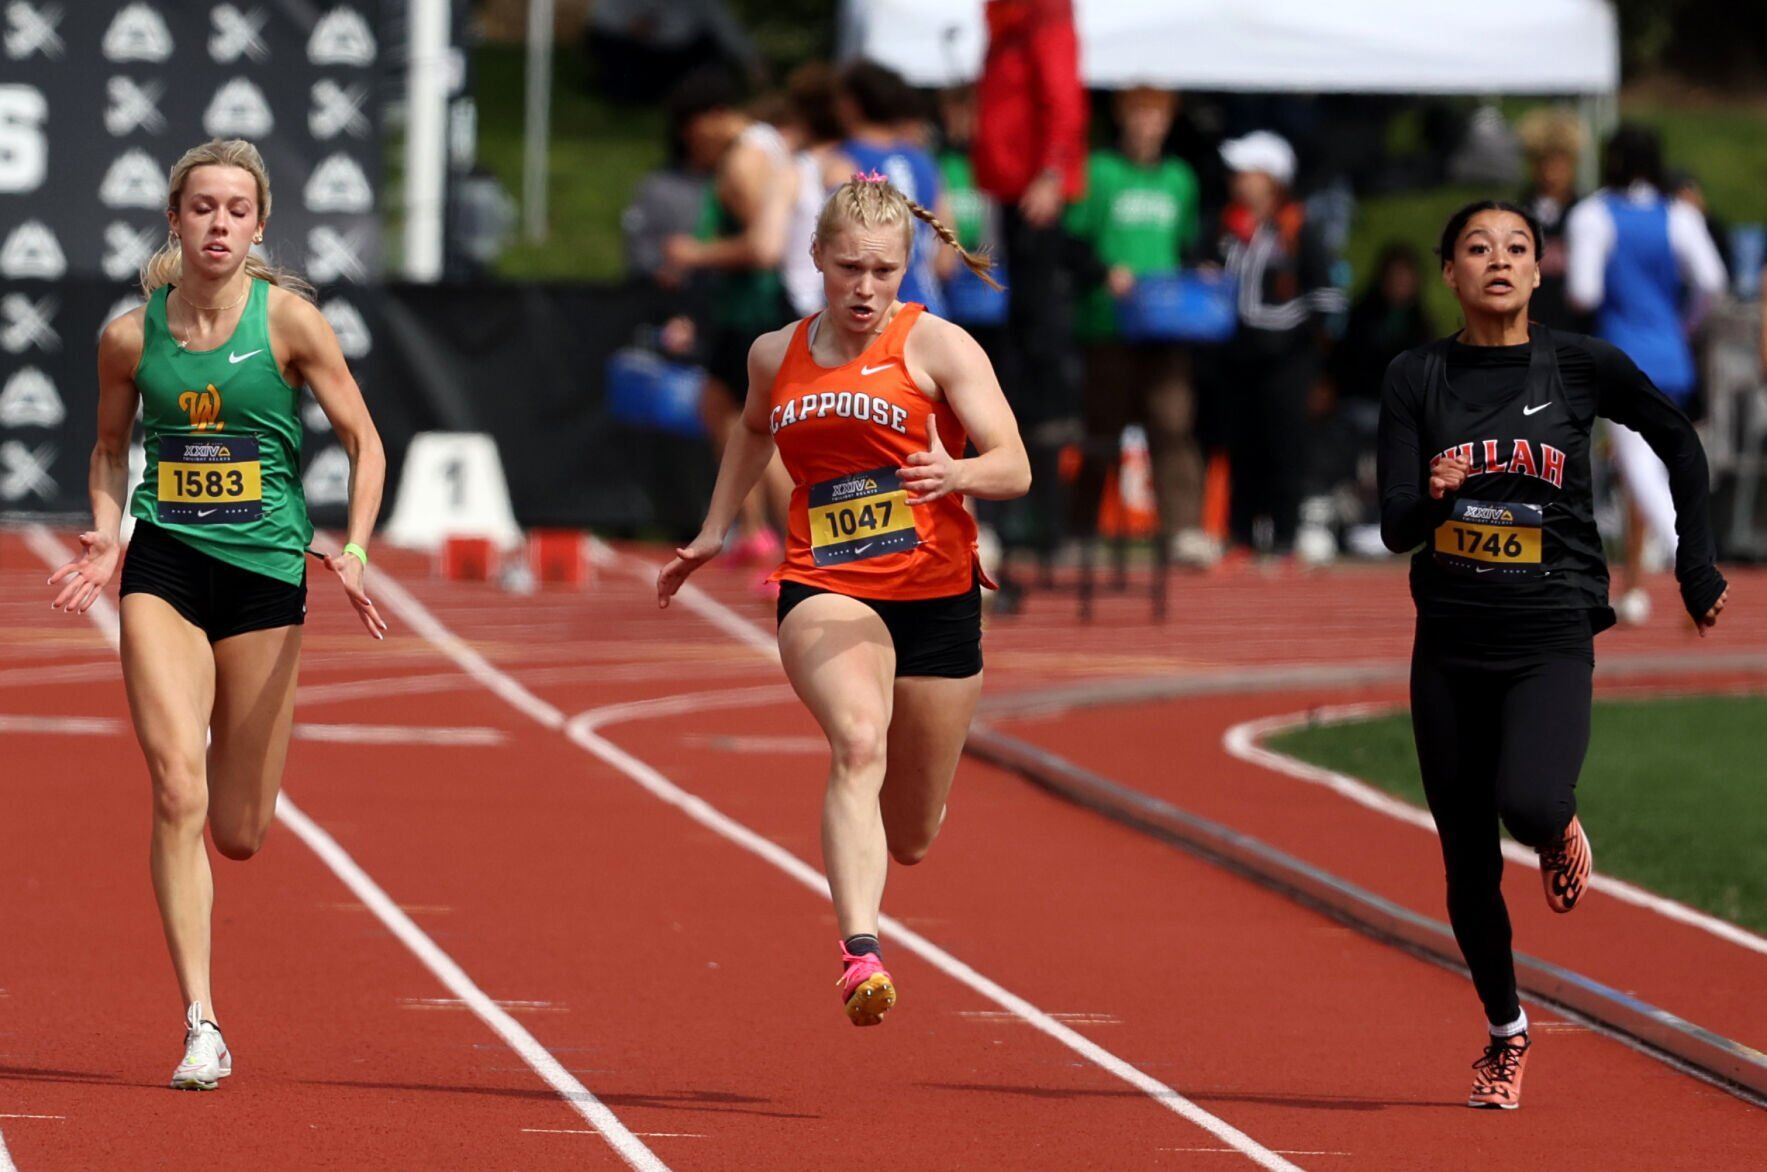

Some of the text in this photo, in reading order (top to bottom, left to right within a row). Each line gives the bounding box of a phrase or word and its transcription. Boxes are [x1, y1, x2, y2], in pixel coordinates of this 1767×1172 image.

[1429, 438, 1567, 489] LLAH
[173, 469, 244, 498] 1583
[825, 500, 893, 538] 1047
[1452, 527, 1522, 558] 1746
